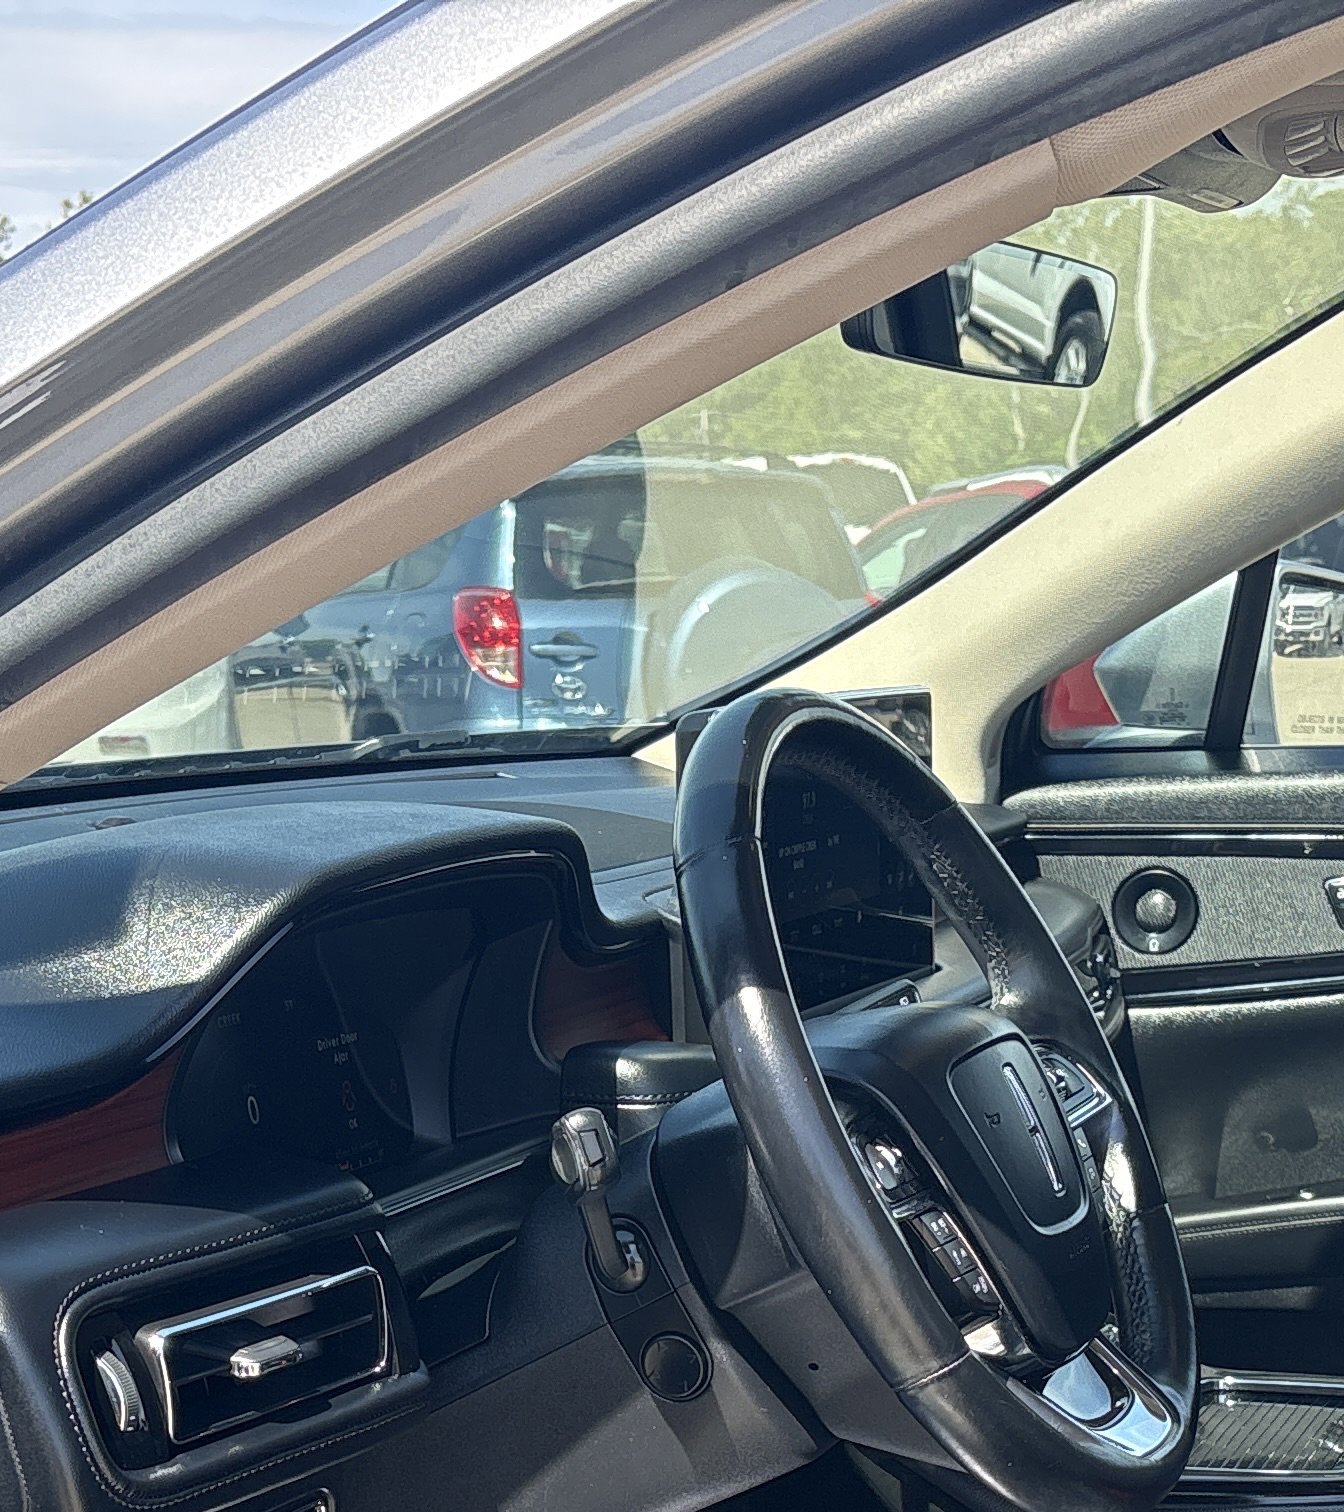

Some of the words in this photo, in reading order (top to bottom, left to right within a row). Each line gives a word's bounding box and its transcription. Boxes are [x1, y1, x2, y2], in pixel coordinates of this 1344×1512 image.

[1297, 714, 1326, 724] OBJECTS
[317, 1037, 340, 1052] Driver
[340, 1032, 359, 1046] Door
[333, 1051, 349, 1067] Ajar
